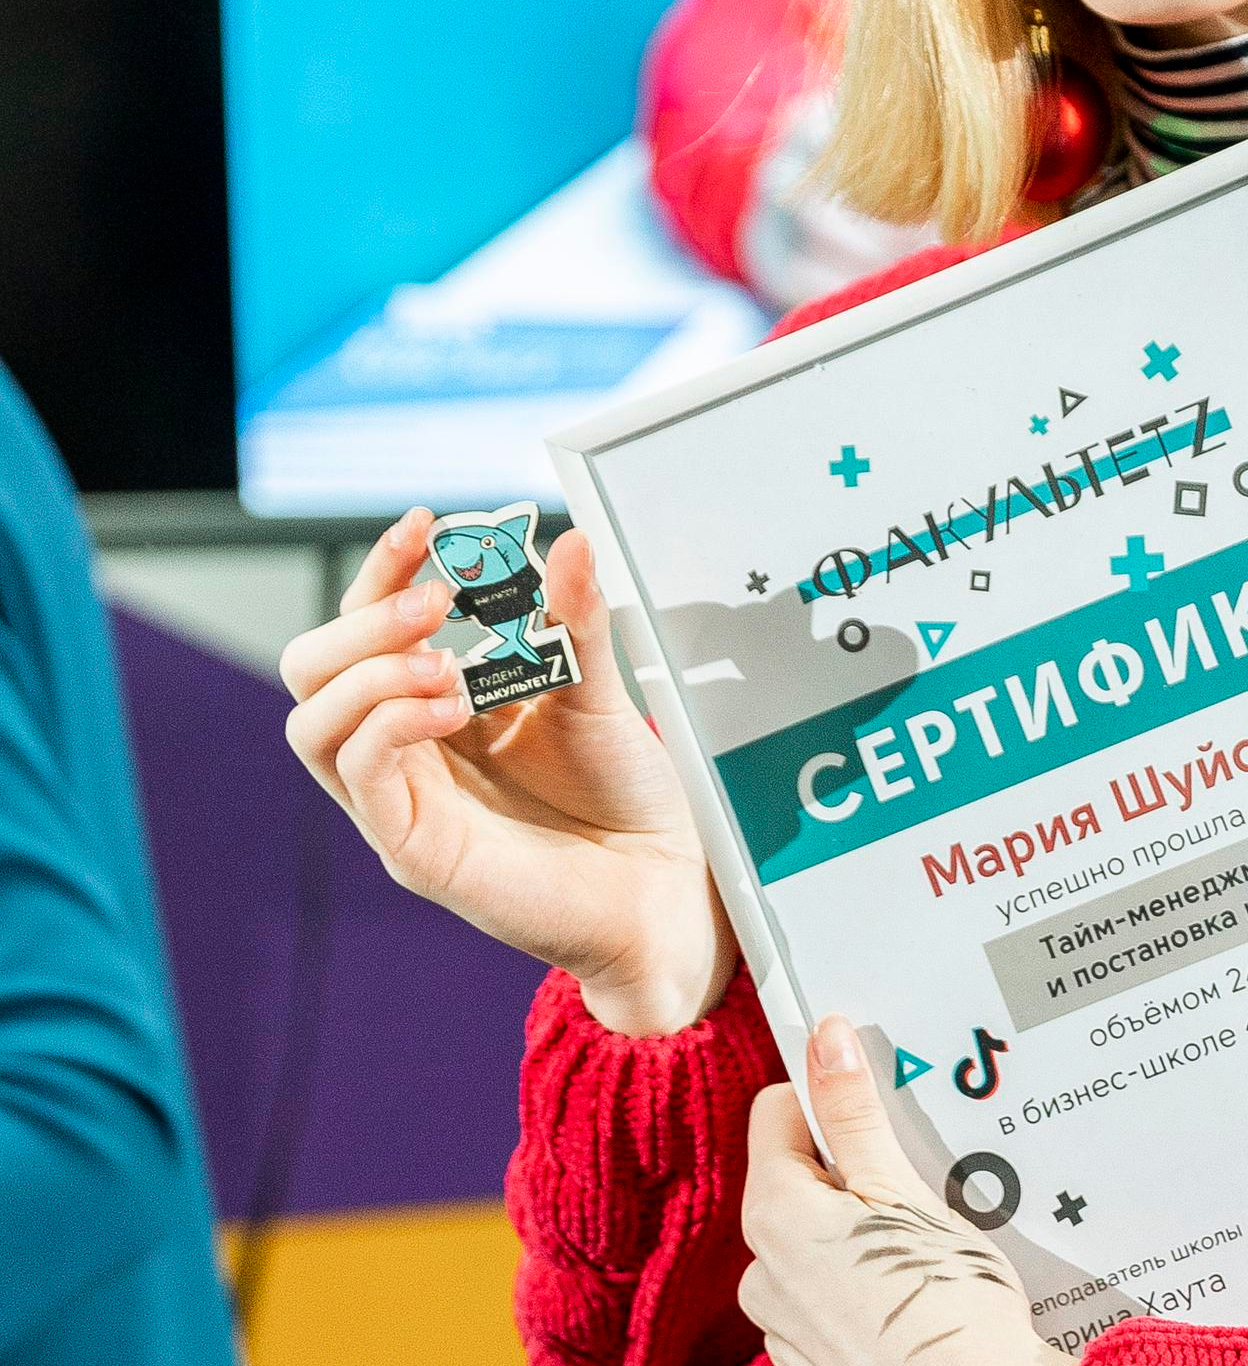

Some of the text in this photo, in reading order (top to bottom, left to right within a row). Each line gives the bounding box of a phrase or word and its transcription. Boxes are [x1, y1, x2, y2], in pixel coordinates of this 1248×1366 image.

[470, 665, 524, 690] СТУДЕНТ
[920, 802, 1101, 897] Мария
[995, 854, 1125, 926] успешно
[1132, 807, 1247, 866] прошла
[1046, 974, 1067, 998] и
[1073, 908, 1239, 988] постановка
[1090, 983, 1221, 1047] объёмом
[998, 1115, 1016, 1135] в
[1022, 1025, 1237, 1125] бизнес-школе
[1031, 1255, 1166, 1316] еподаватель
[1170, 1225, 1244, 1262] школы
[1045, 1273, 1227, 1356] арин Хаута
